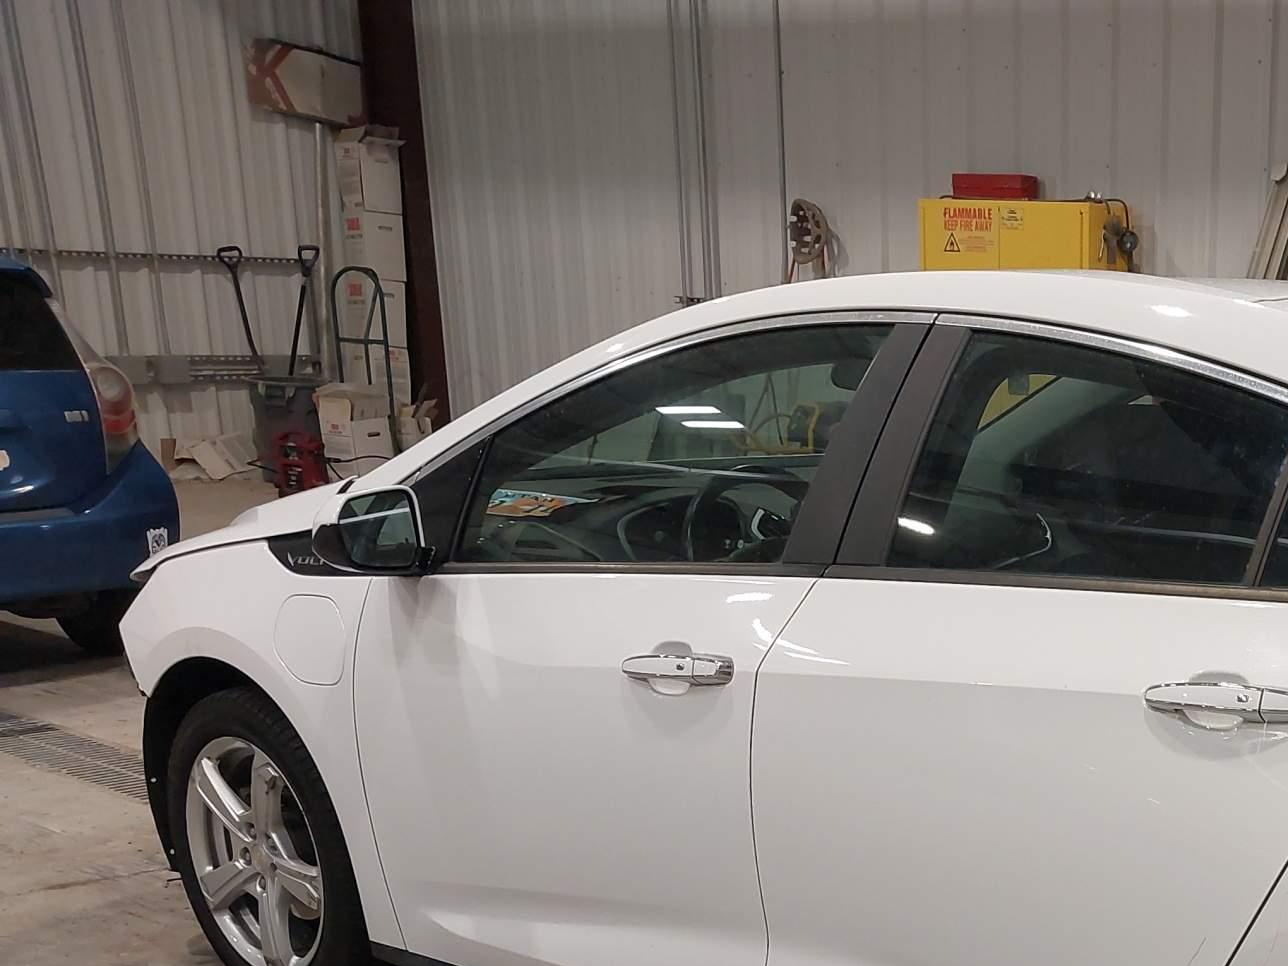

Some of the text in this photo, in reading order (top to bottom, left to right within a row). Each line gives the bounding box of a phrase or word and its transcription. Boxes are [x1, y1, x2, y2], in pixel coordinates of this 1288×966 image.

[944, 207, 993, 220] FLAMMABLE
[944, 219, 993, 232] KEEP FIRE AWAY
